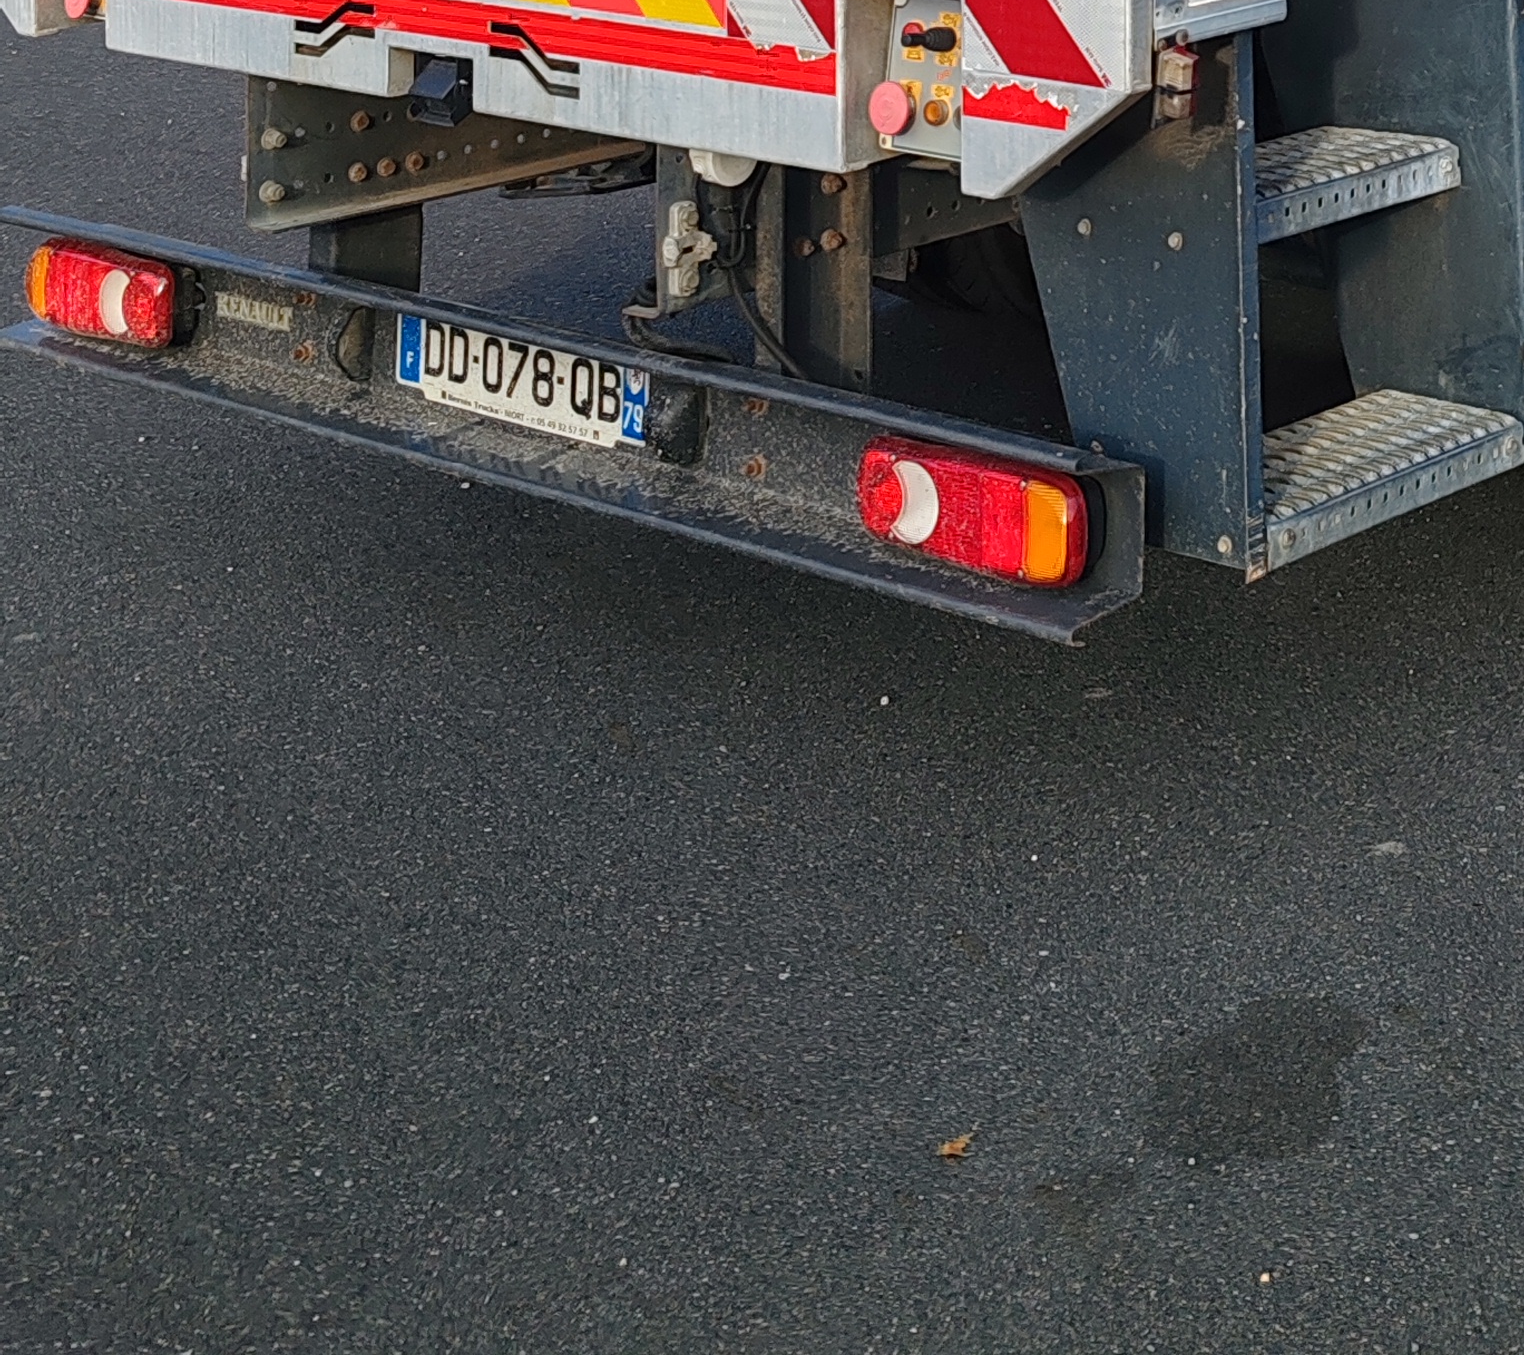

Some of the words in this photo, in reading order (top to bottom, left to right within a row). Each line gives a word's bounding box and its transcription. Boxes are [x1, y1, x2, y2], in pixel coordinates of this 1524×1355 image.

[215, 291, 293, 331] RENAULT
[406, 351, 414, 368] F
[424, 320, 621, 423] DD-078-QB
[623, 400, 644, 433] 79
